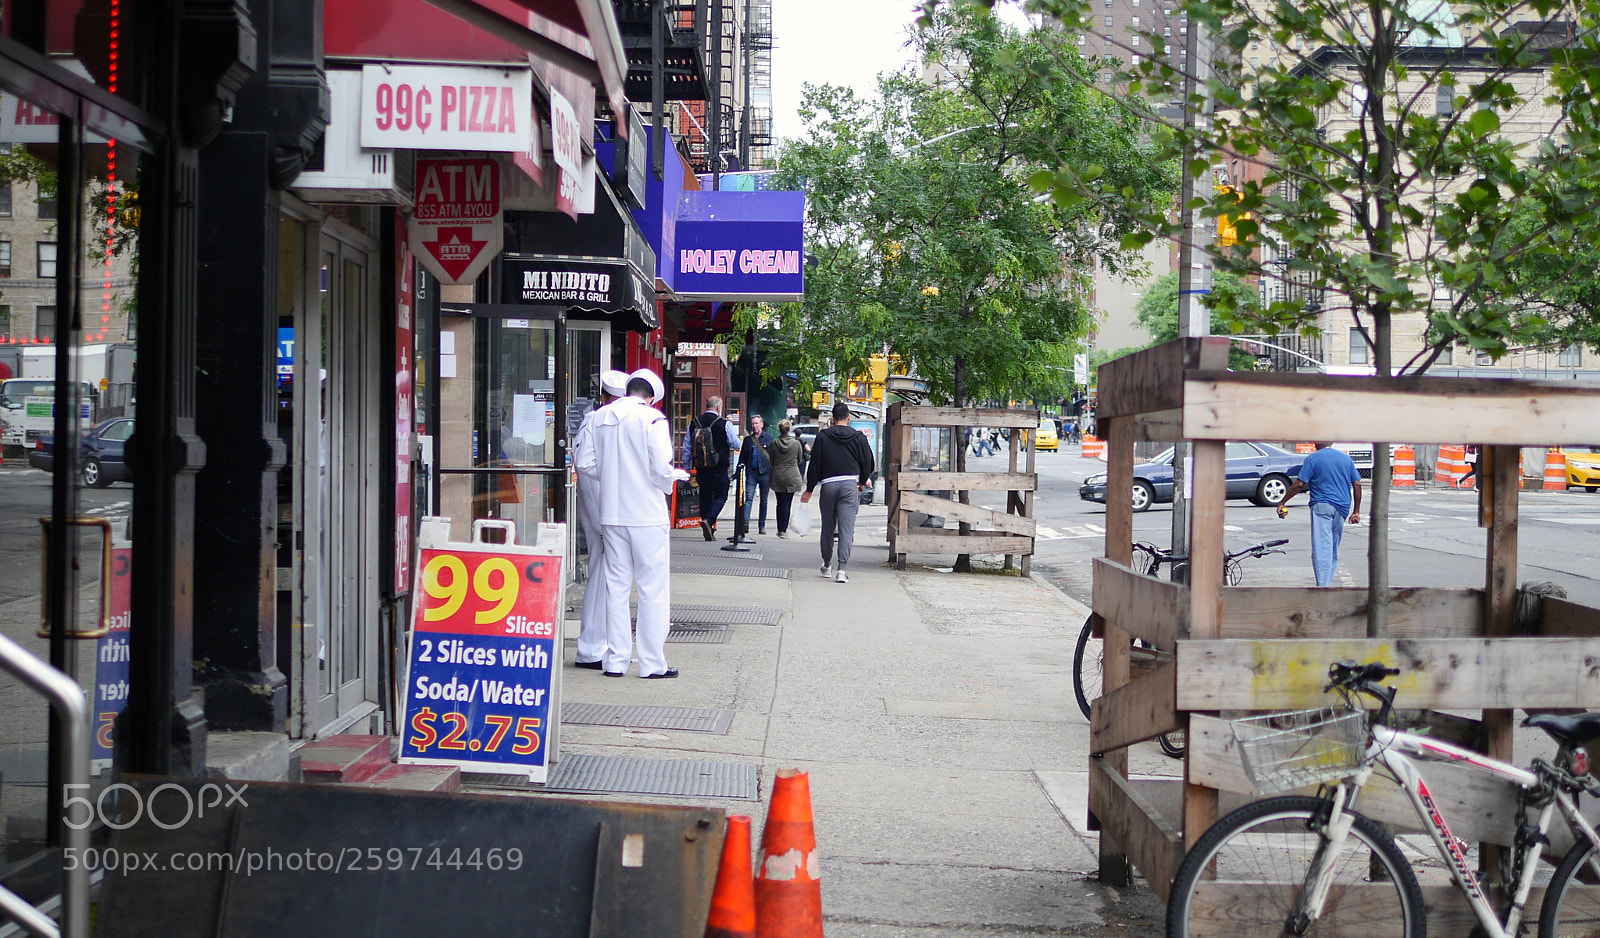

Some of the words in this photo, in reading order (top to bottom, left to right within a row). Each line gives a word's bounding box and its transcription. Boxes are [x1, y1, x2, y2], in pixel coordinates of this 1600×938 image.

[375, 83, 433, 135] 99¢
[440, 85, 516, 134] PIZZA
[418, 164, 492, 203] ATM
[417, 203, 436, 218] 855
[439, 203, 462, 218] ATM
[464, 203, 492, 217] 4YOU
[417, 219, 492, 227] www.atm4you.com
[440, 244, 471, 254] ATM
[680, 249, 737, 274] HOLEY
[739, 249, 799, 274] CREAM
[523, 271, 548, 290] MI
[550, 271, 611, 293] NIDITO
[522, 290, 560, 300] MEXICAN
[561, 290, 577, 300] BAR
[578, 292, 585, 301] &
[586, 292, 611, 303] GRILL
[423, 554, 520, 625] 99
[505, 616, 552, 636] Slices
[418, 640, 432, 662] 2
[437, 640, 496, 667] Slices
[501, 644, 548, 669] with
[409, 706, 541, 756] $2.75
